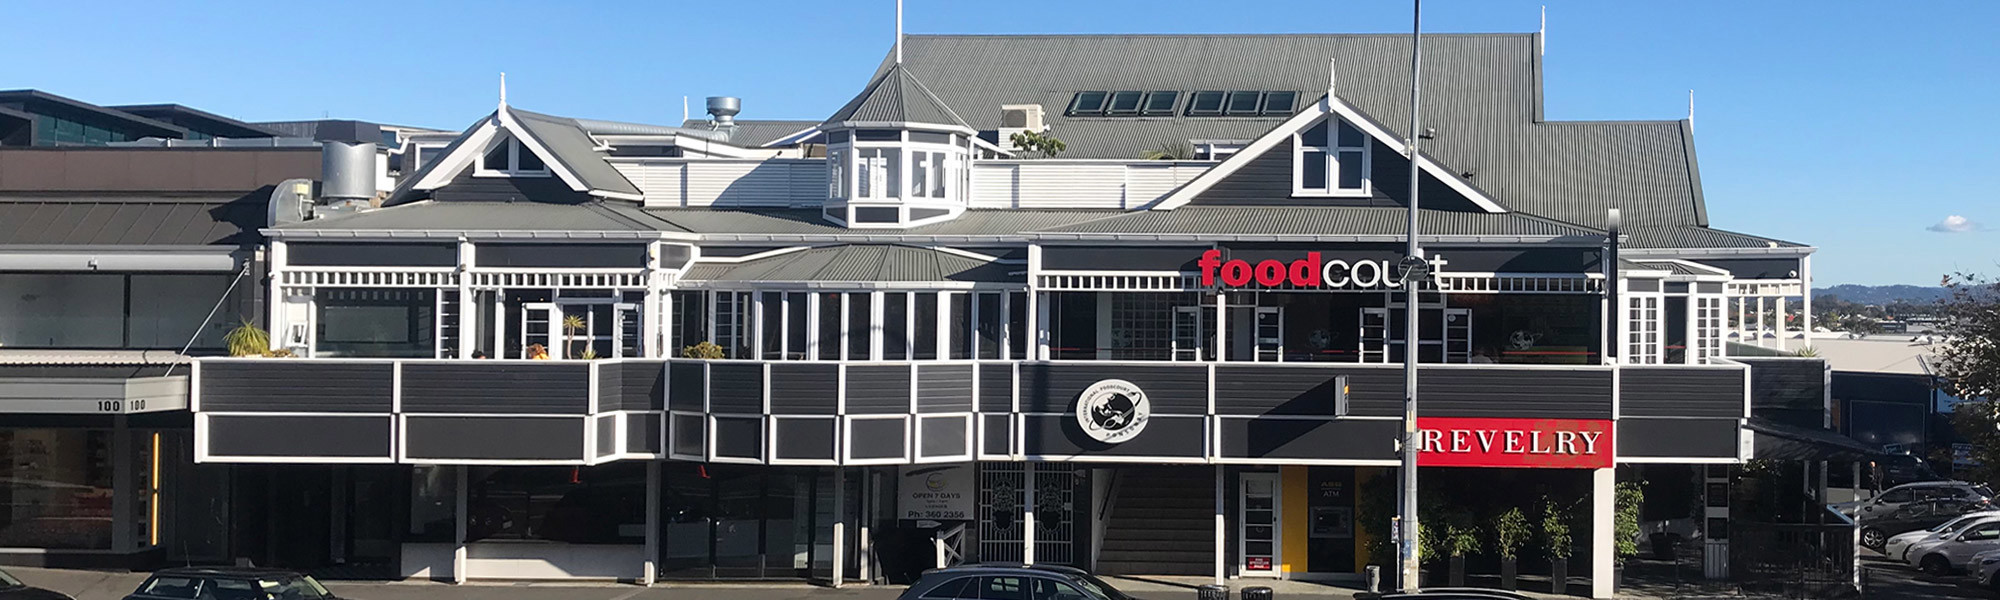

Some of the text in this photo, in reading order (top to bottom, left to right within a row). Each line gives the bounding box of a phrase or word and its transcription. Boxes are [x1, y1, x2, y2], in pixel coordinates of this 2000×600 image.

[1198, 249, 1448, 288] foodcout
[1100, 384, 1130, 393] FOODCOURT
[98, 400, 120, 412] 100
[130, 399, 146, 411] 100
[1421, 429, 1603, 455] REVELRY
[907, 510, 923, 518] Ph:
